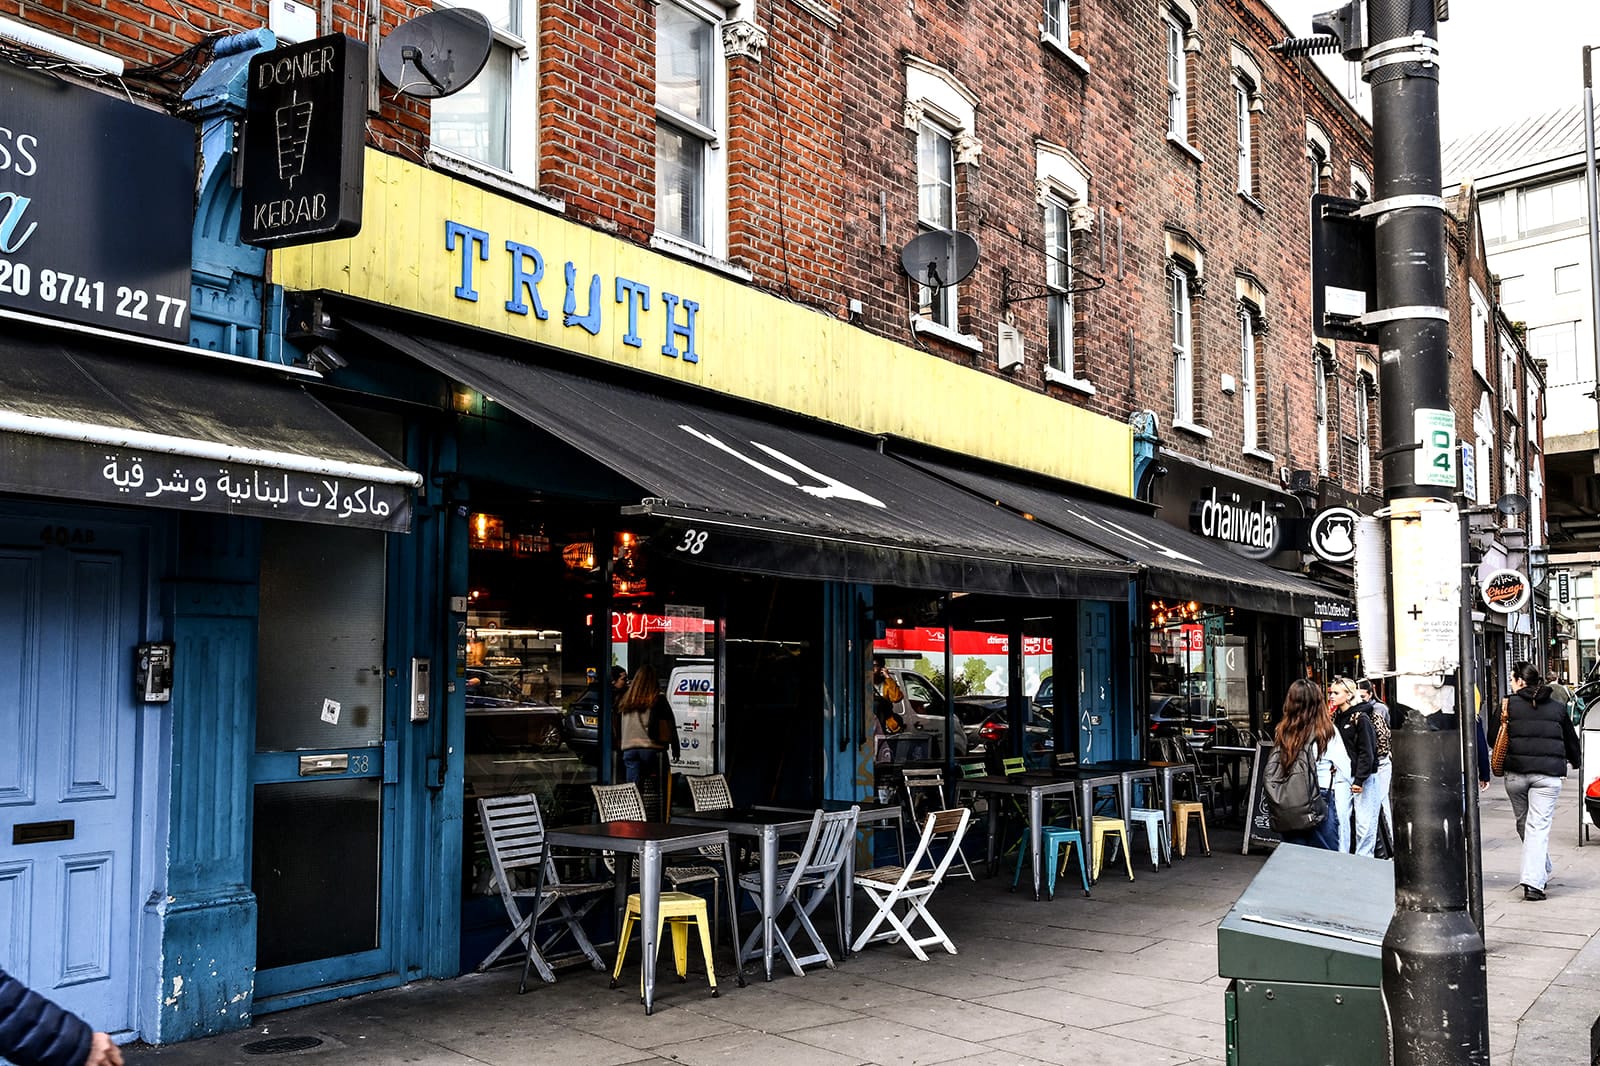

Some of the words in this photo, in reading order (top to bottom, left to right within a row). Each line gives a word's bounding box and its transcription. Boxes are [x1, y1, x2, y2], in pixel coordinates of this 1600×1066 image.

[259, 46, 335, 90] DONER
[253, 193, 327, 231] KEBAB
[39, 269, 105, 312] 8741
[115, 286, 149, 321] 22
[156, 294, 187, 328] 77
[445, 220, 700, 363] TRUTH
[216, 470, 289, 508] لبنانية
[298, 480, 390, 518] ماكولات
[675, 529, 709, 555] 38
[351, 755, 369, 774] 38
